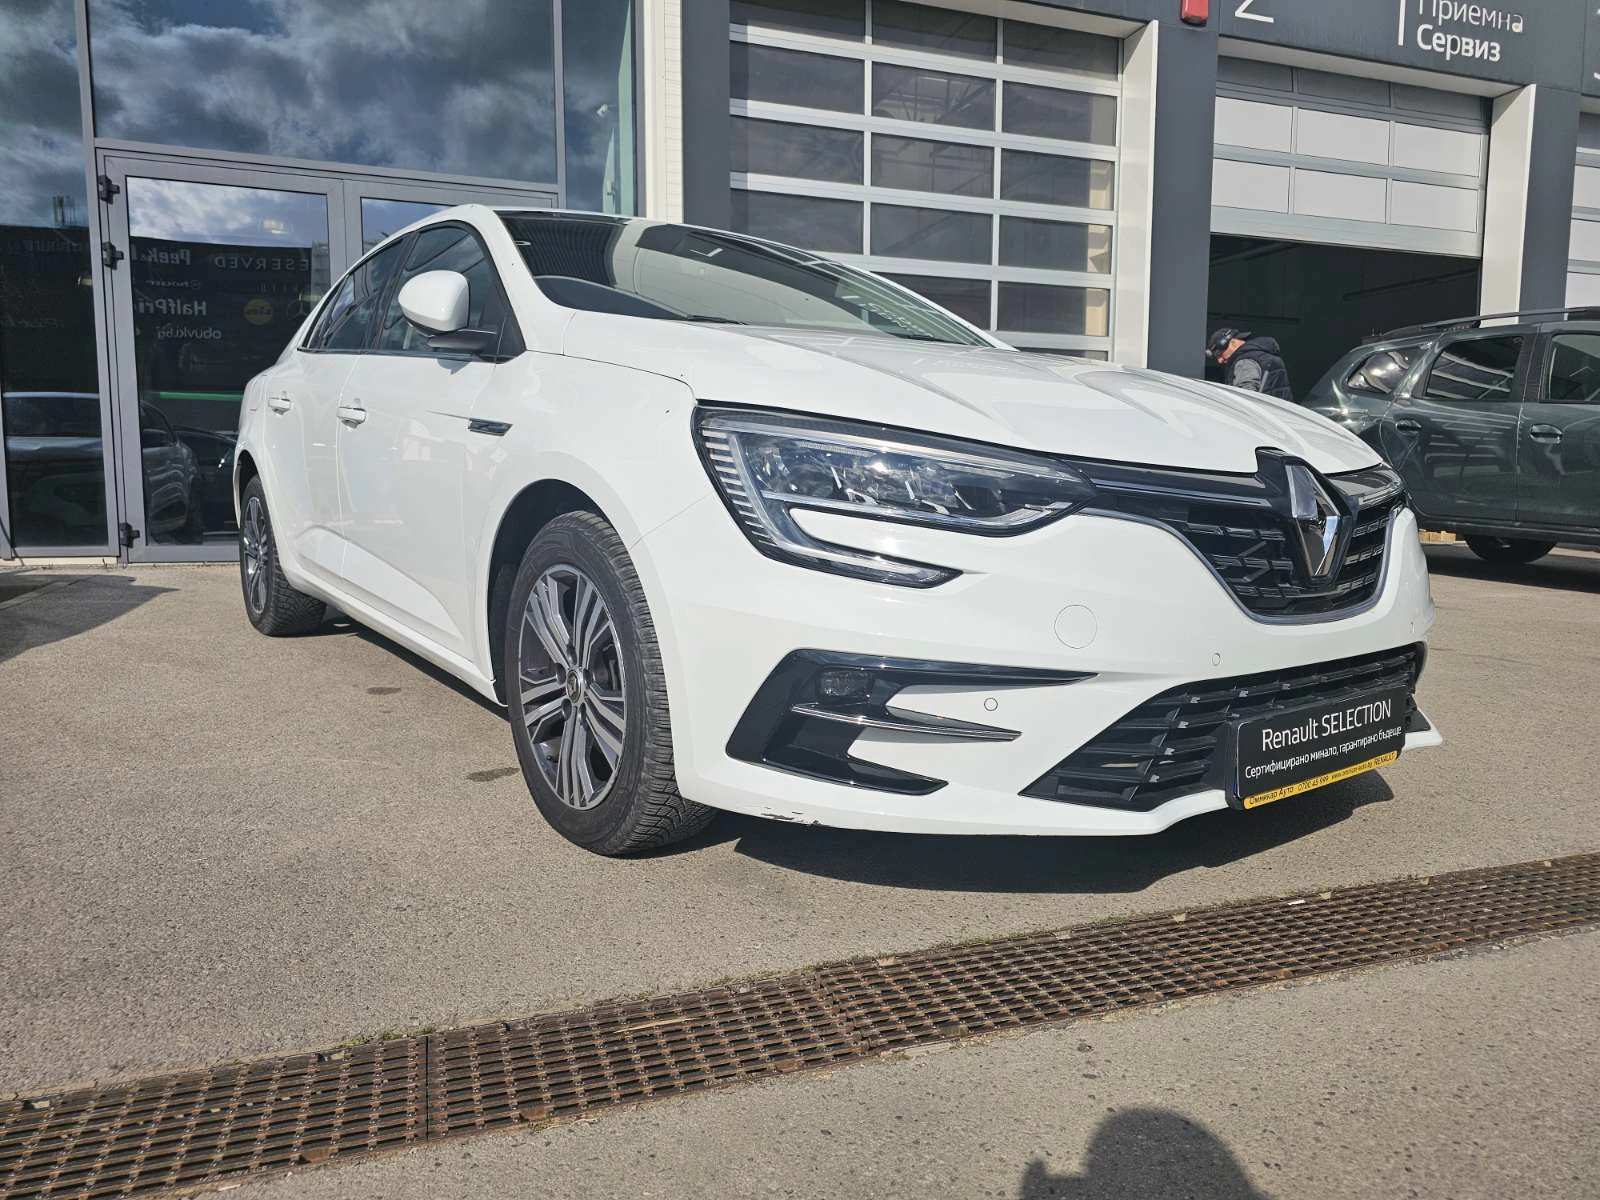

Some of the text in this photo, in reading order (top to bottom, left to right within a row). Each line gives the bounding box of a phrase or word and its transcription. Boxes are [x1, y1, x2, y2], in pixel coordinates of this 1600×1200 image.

[1418, 0, 1524, 33] Приемна
[1416, 23, 1502, 62] Сервиз
[1261, 698, 1392, 751] Renault SELECTION
[1244, 755, 1310, 780] Сертифицирано
[1310, 747, 1339, 761] минало,
[1339, 732, 1379, 754] гарантирано
